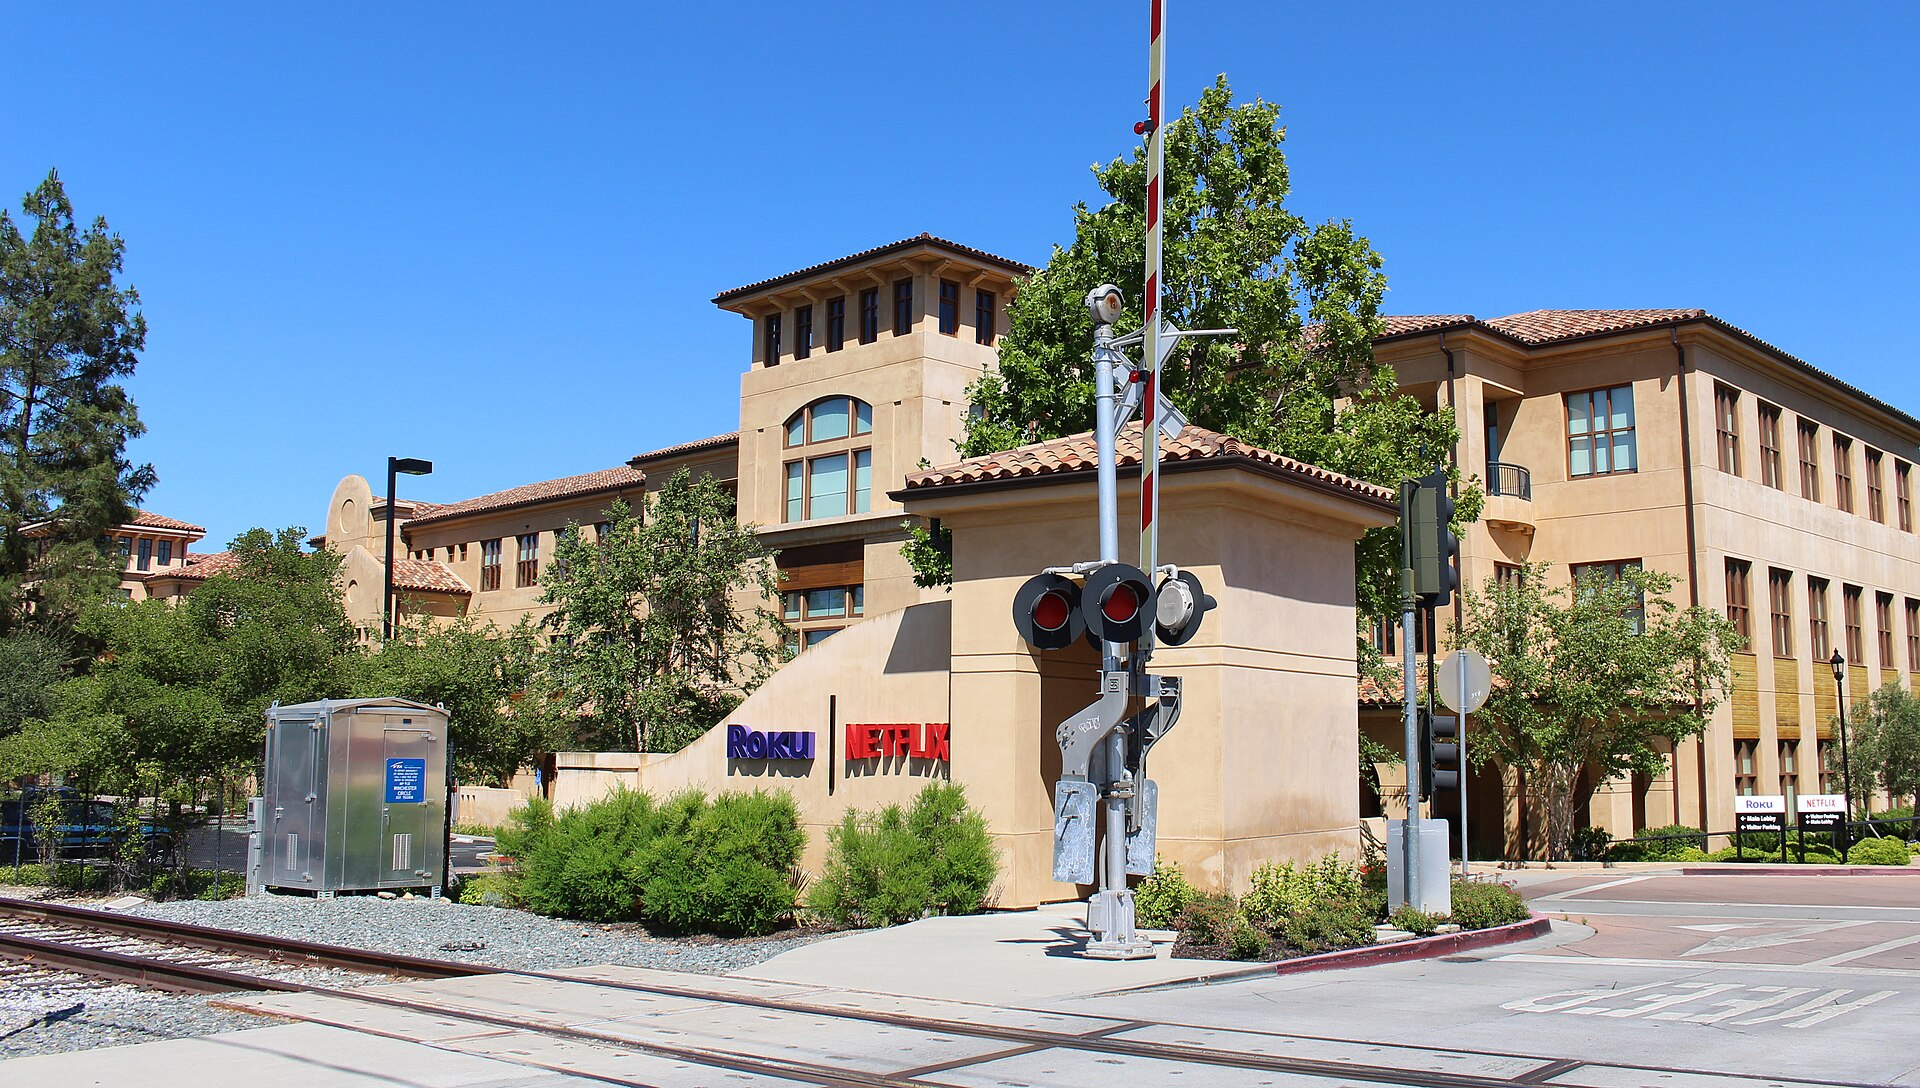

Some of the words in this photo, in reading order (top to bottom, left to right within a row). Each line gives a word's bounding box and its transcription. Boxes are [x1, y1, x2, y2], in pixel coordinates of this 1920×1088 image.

[845, 723, 949, 761] NETFLIX
[1806, 799, 1836, 808] NETFLIX
[1760, 815, 1777, 823] Lobby
[1499, 981, 1901, 1028] KEEP
